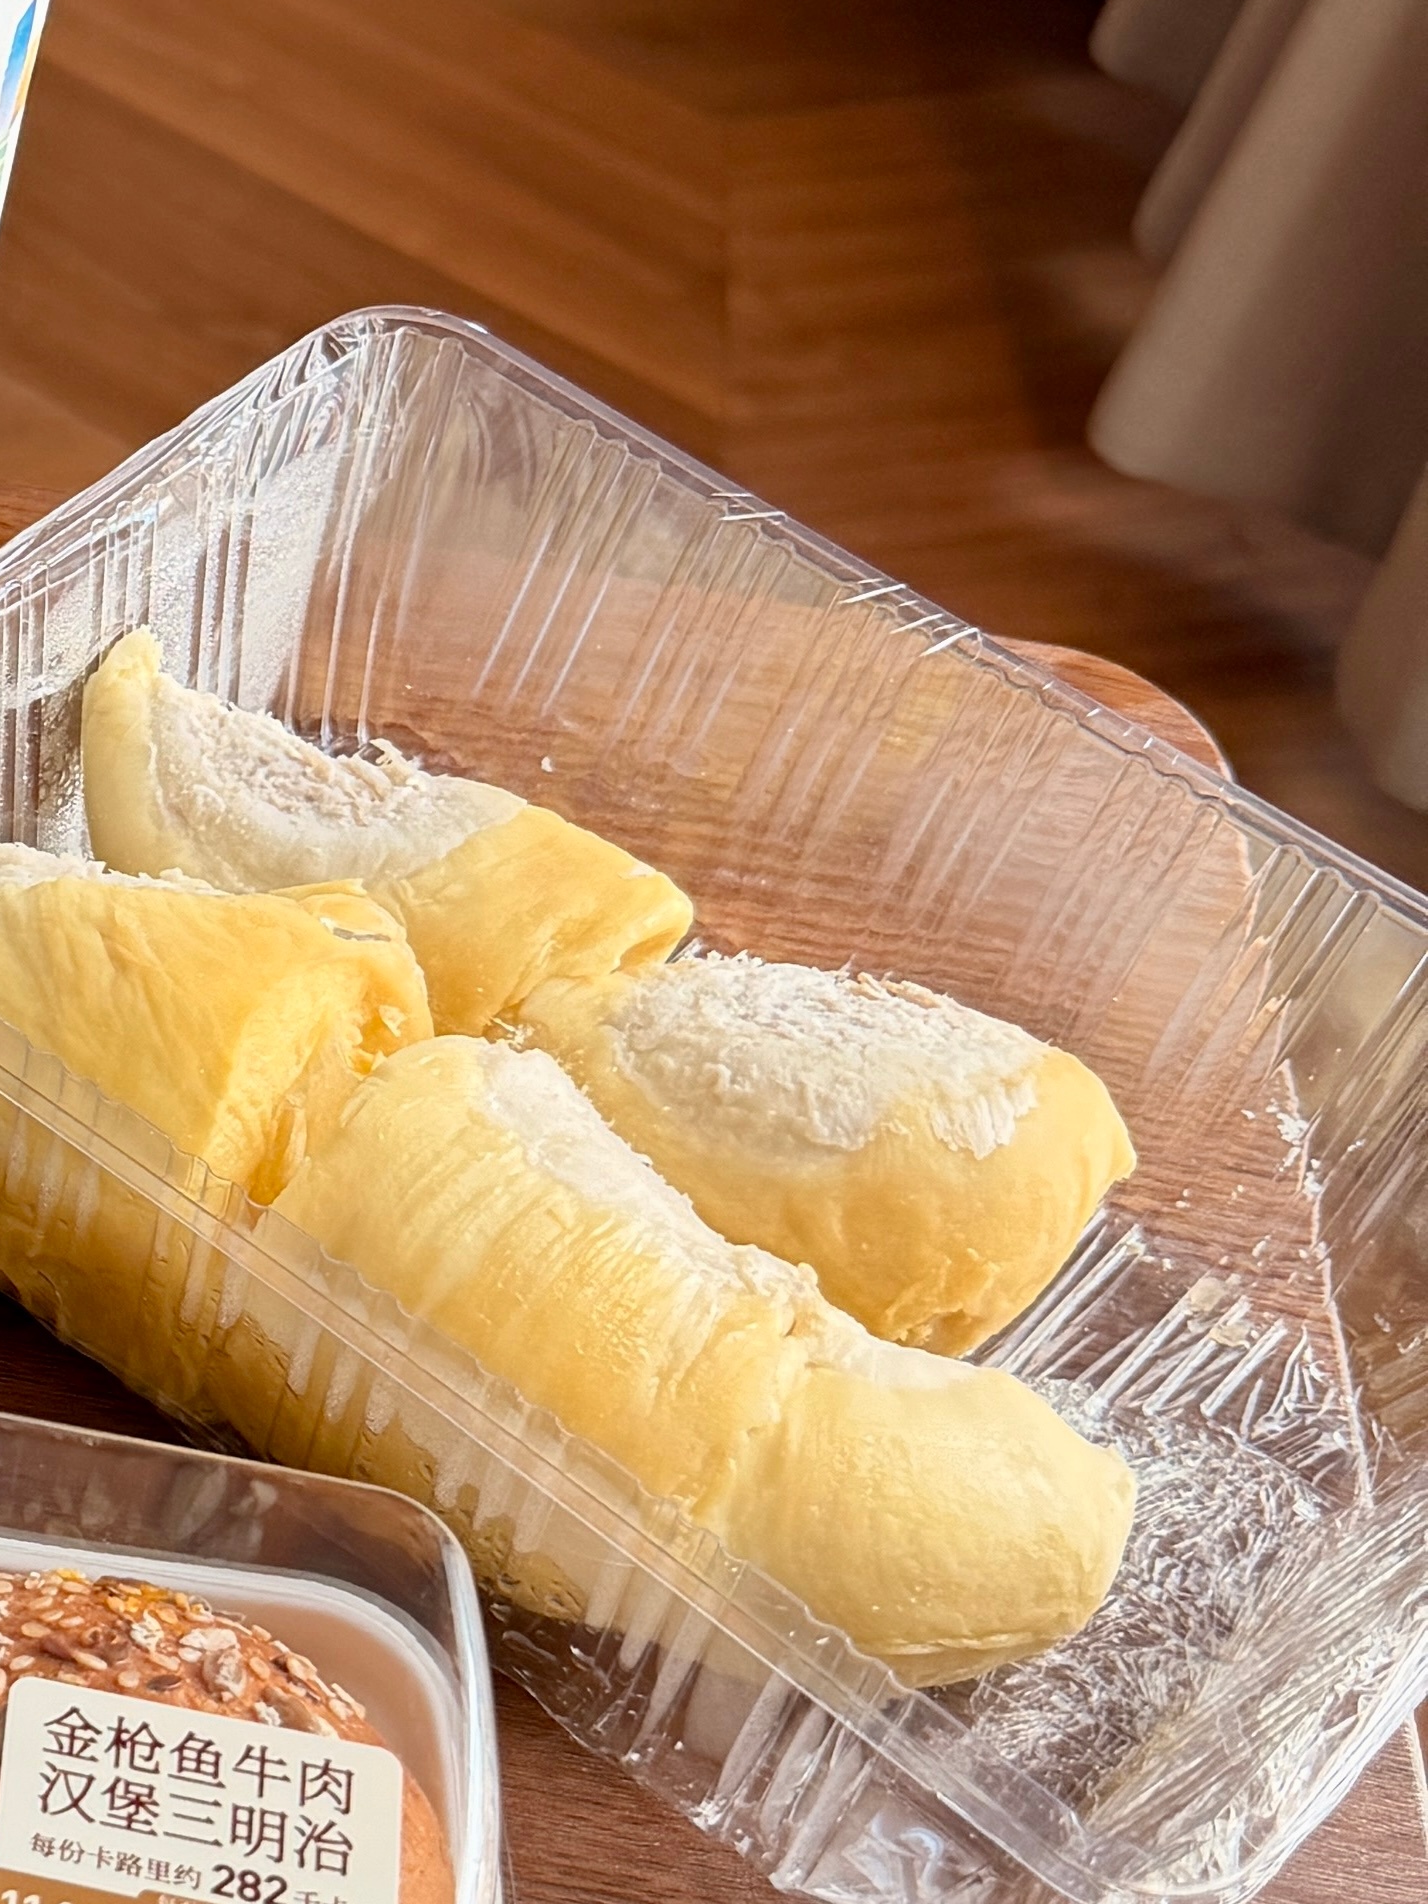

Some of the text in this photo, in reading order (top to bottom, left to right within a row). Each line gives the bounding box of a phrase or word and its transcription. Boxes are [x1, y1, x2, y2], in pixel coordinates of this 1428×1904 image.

[42, 1705, 355, 1815] 金枪鱼牛肉
[37, 1761, 354, 1876] 汉堡三明治
